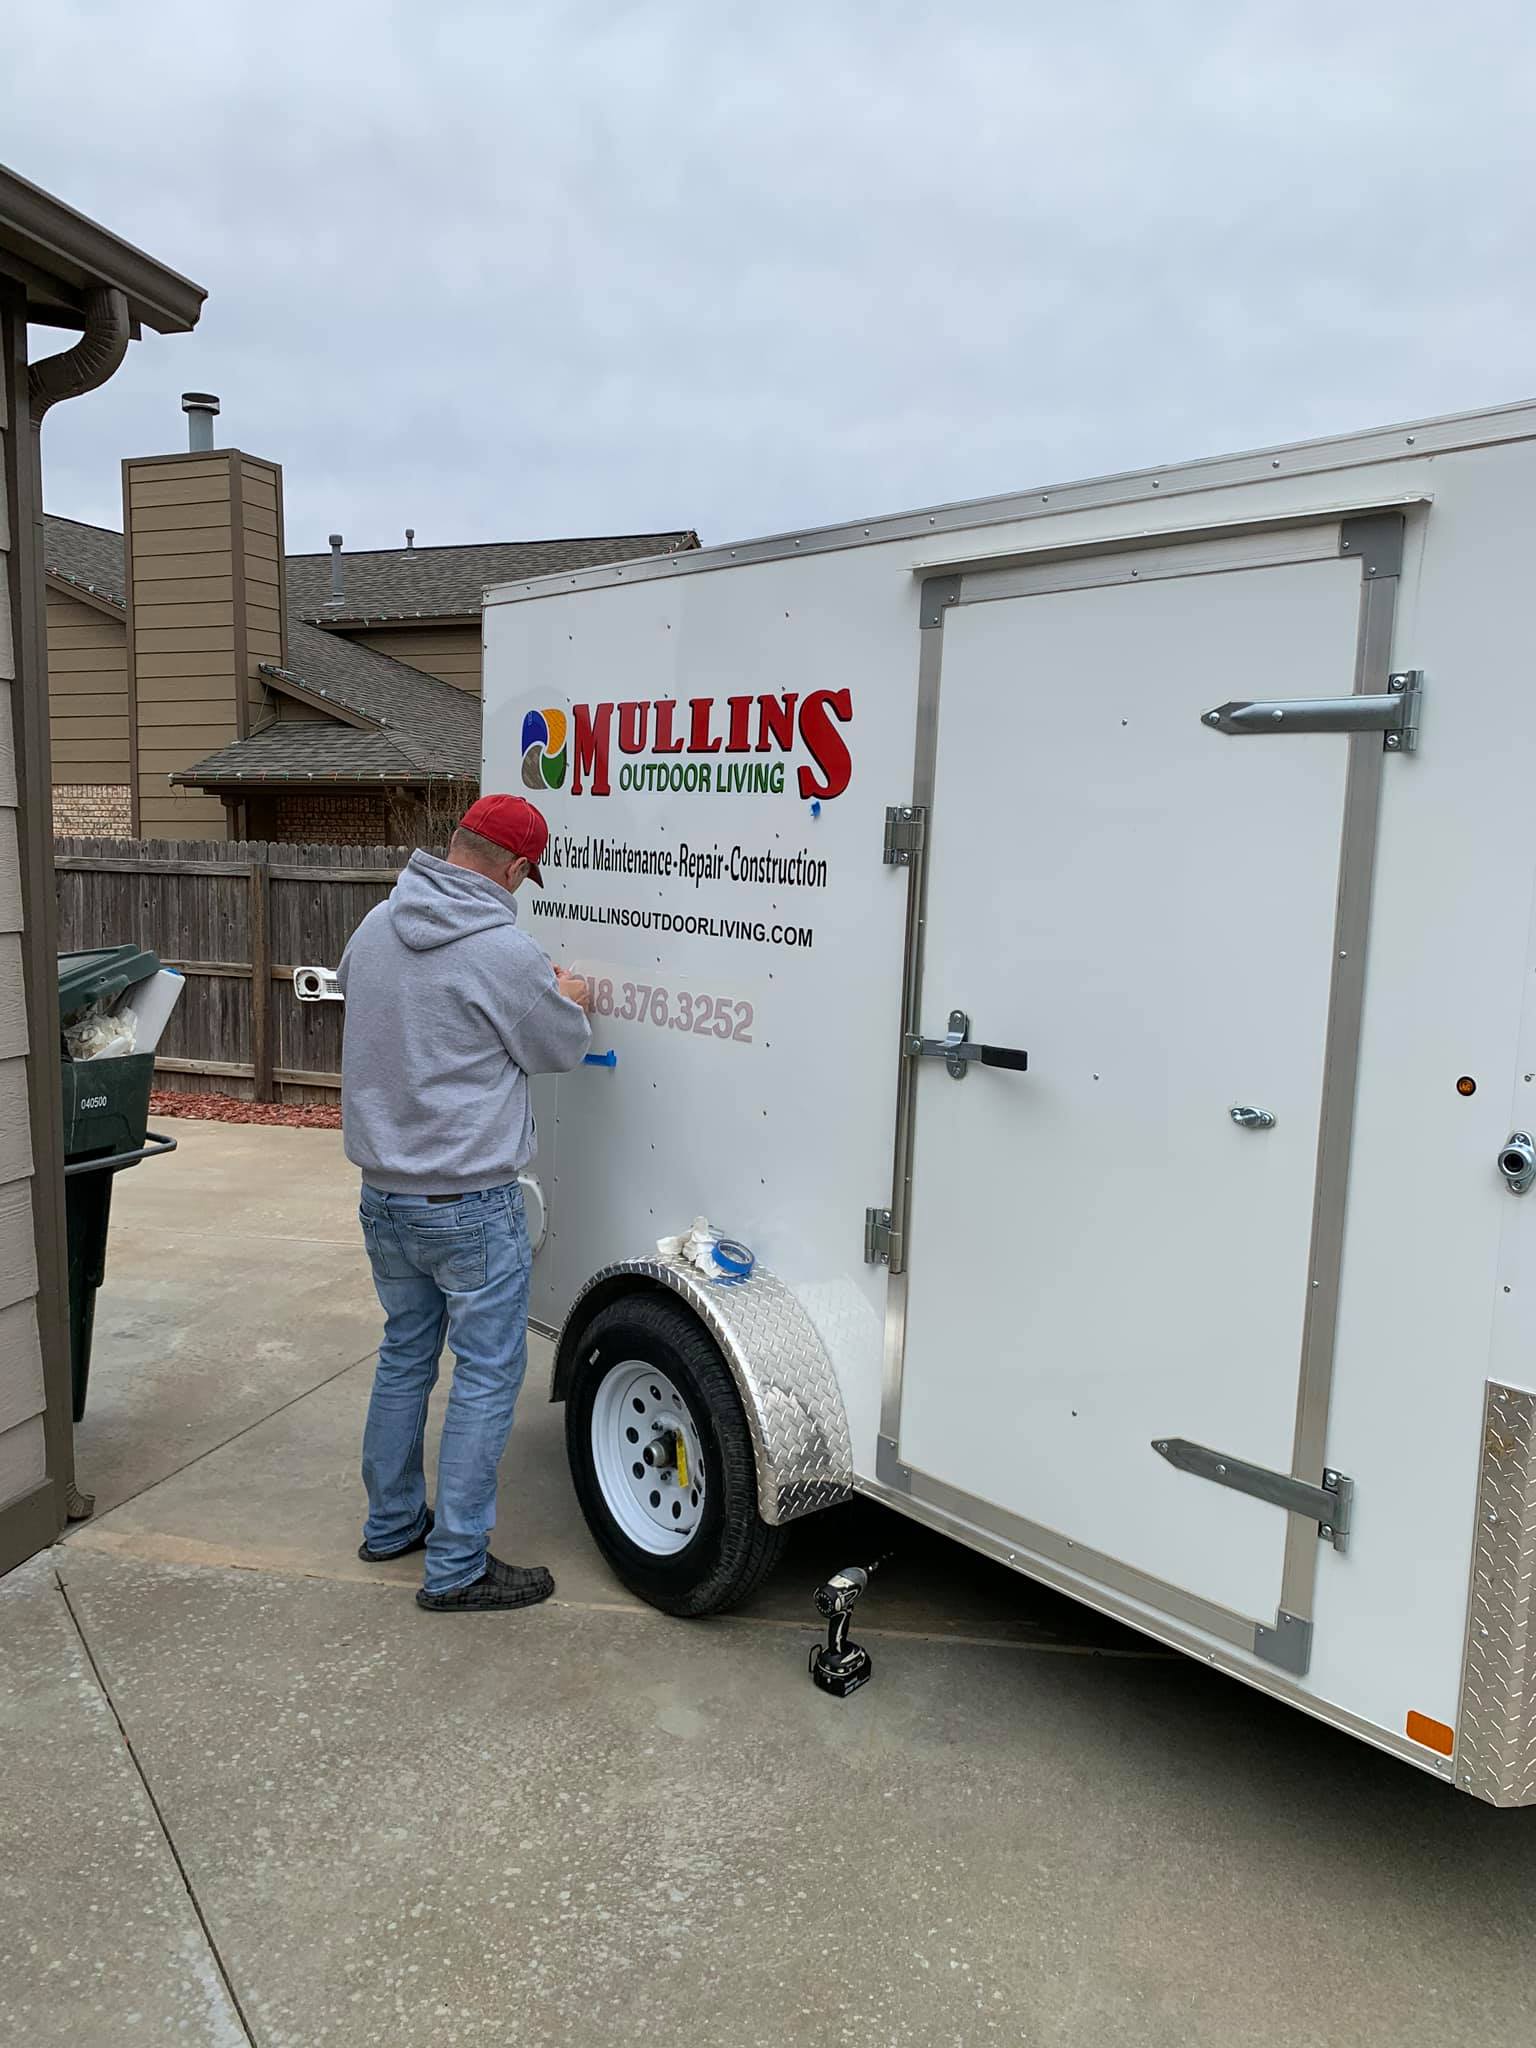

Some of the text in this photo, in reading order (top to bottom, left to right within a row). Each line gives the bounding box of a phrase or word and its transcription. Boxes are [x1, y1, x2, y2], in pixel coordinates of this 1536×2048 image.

[571, 688, 853, 800] MULLINS
[619, 762, 785, 794] OUTDOOR LIVING
[553, 836, 562, 867] &
[564, 835, 590, 869] Yard
[532, 899, 813, 948] WWW.MULLINSOUTDOORLIVING.COM
[568, 974, 754, 1044] 18.376.3252
[81, 1095, 107, 1110] 040500
